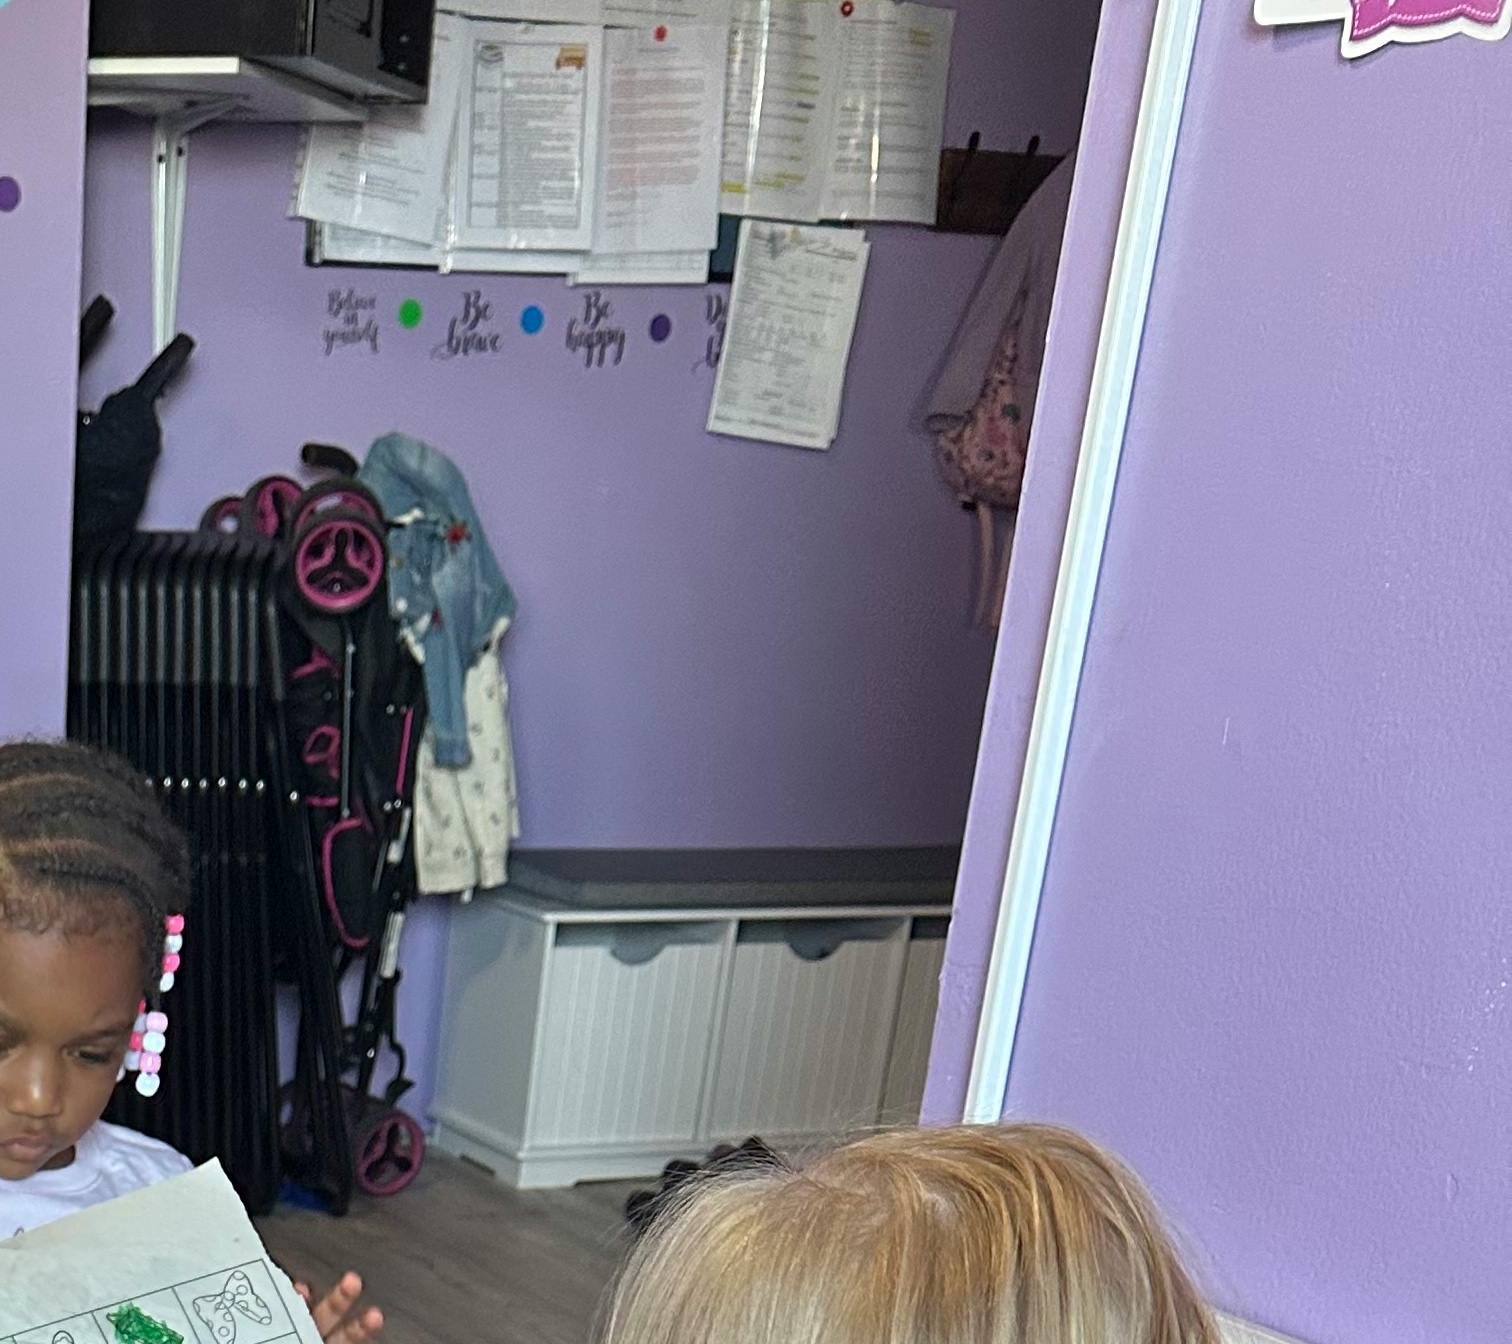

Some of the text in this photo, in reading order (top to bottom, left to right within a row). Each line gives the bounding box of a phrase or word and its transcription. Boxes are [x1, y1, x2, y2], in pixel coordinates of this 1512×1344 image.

[463, 290, 495, 330] Be
[584, 291, 615, 330] Be
[431, 316, 504, 359] brave
[566, 317, 625, 368] happy
